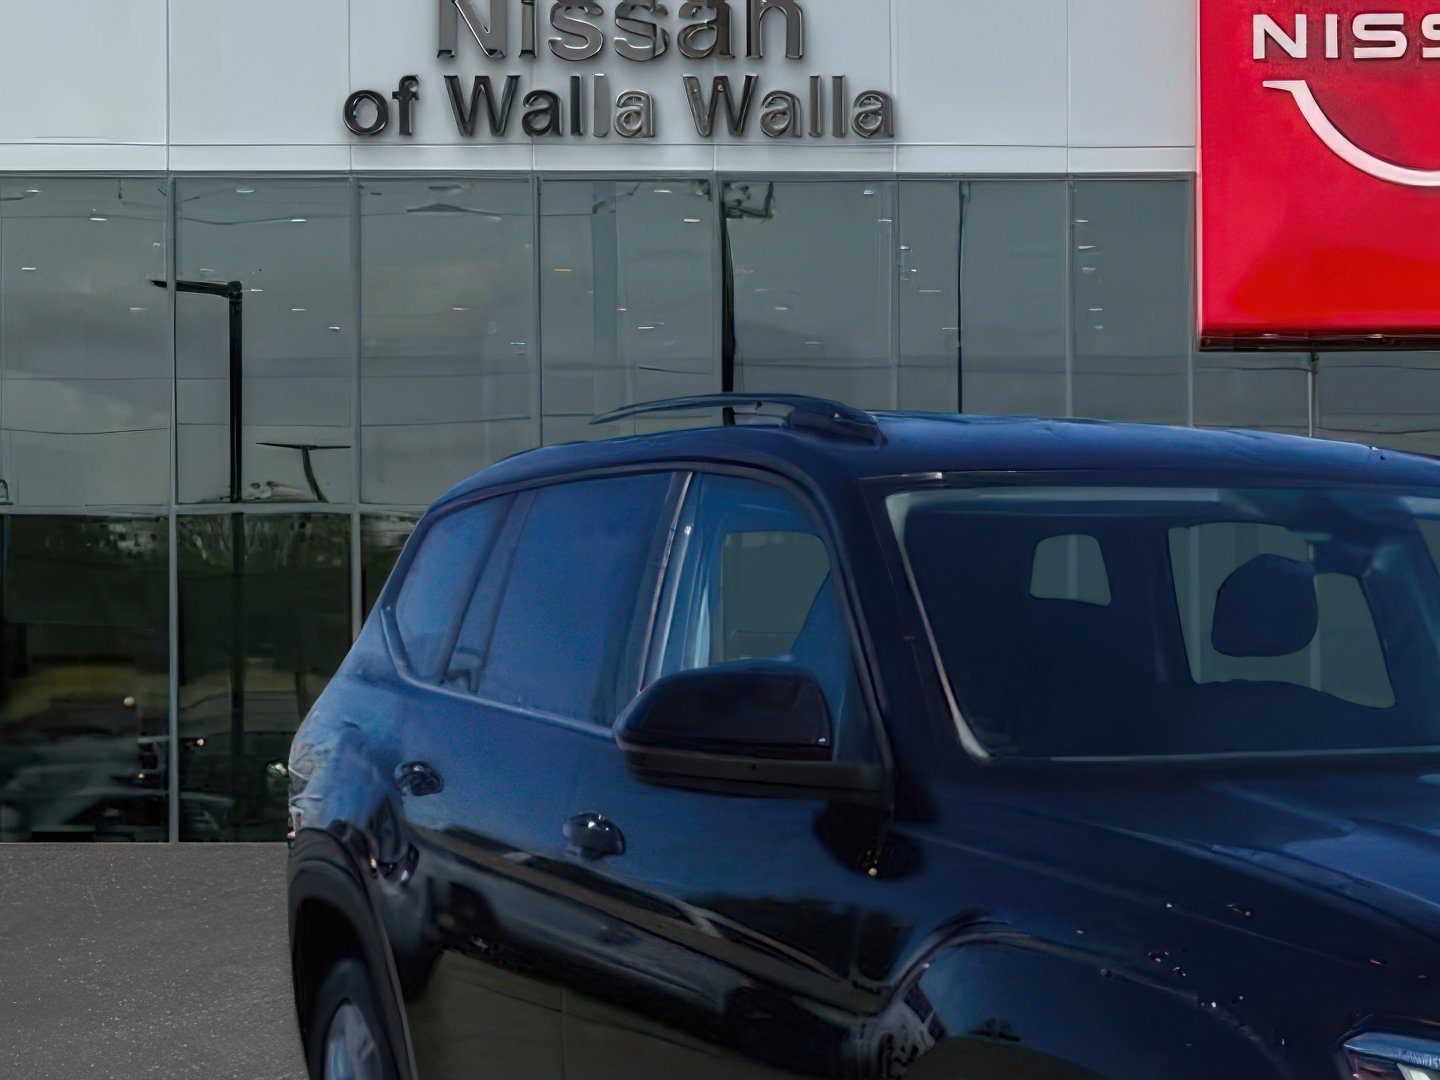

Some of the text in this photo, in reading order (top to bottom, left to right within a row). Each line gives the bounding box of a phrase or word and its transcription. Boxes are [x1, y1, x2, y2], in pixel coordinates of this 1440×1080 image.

[437, 0, 805, 61] Nissan
[342, 73, 895, 138] of Walla Walla
